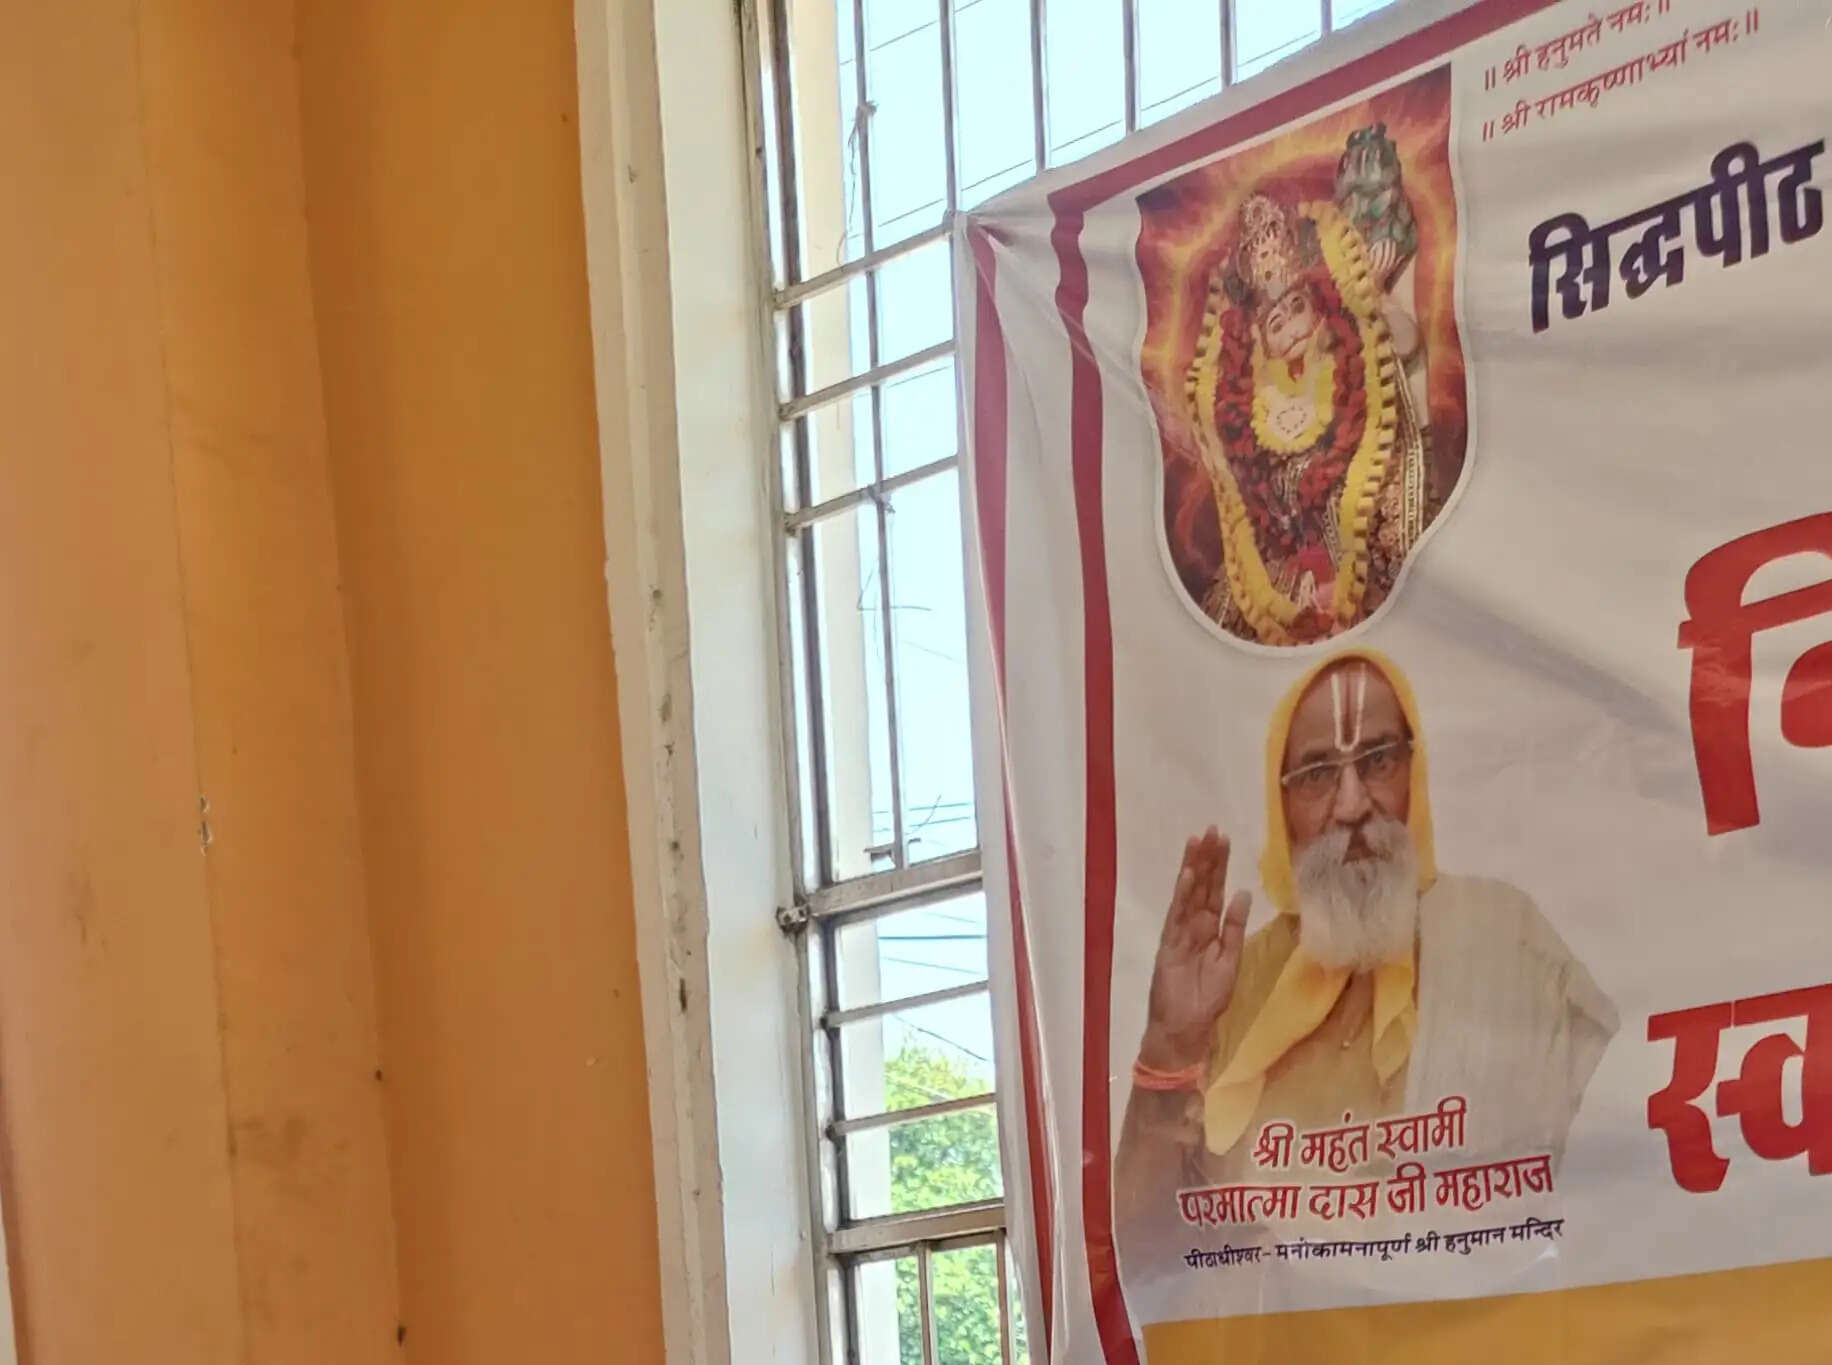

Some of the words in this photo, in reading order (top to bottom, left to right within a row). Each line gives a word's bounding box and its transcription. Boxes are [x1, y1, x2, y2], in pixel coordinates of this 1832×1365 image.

[1503, 44, 1532, 82] श्री
[1535, 12, 1603, 71] हनुमते
[1501, 100, 1532, 134] श्री
[1253, 1123, 1294, 1168] श्री
[1301, 1112, 1370, 1173] महंत
[1377, 1096, 1467, 1160] स्वामी
[1179, 1186, 1302, 1227] परमात्मा
[1309, 1182, 1380, 1221] दास
[1387, 1162, 1426, 1213] जी
[1434, 1155, 1553, 1212] महाराज
[1415, 1230, 1441, 1253] श्री
[1443, 1227, 1507, 1255] हनुमान
[1509, 1217, 1565, 1241] मन्दिर
